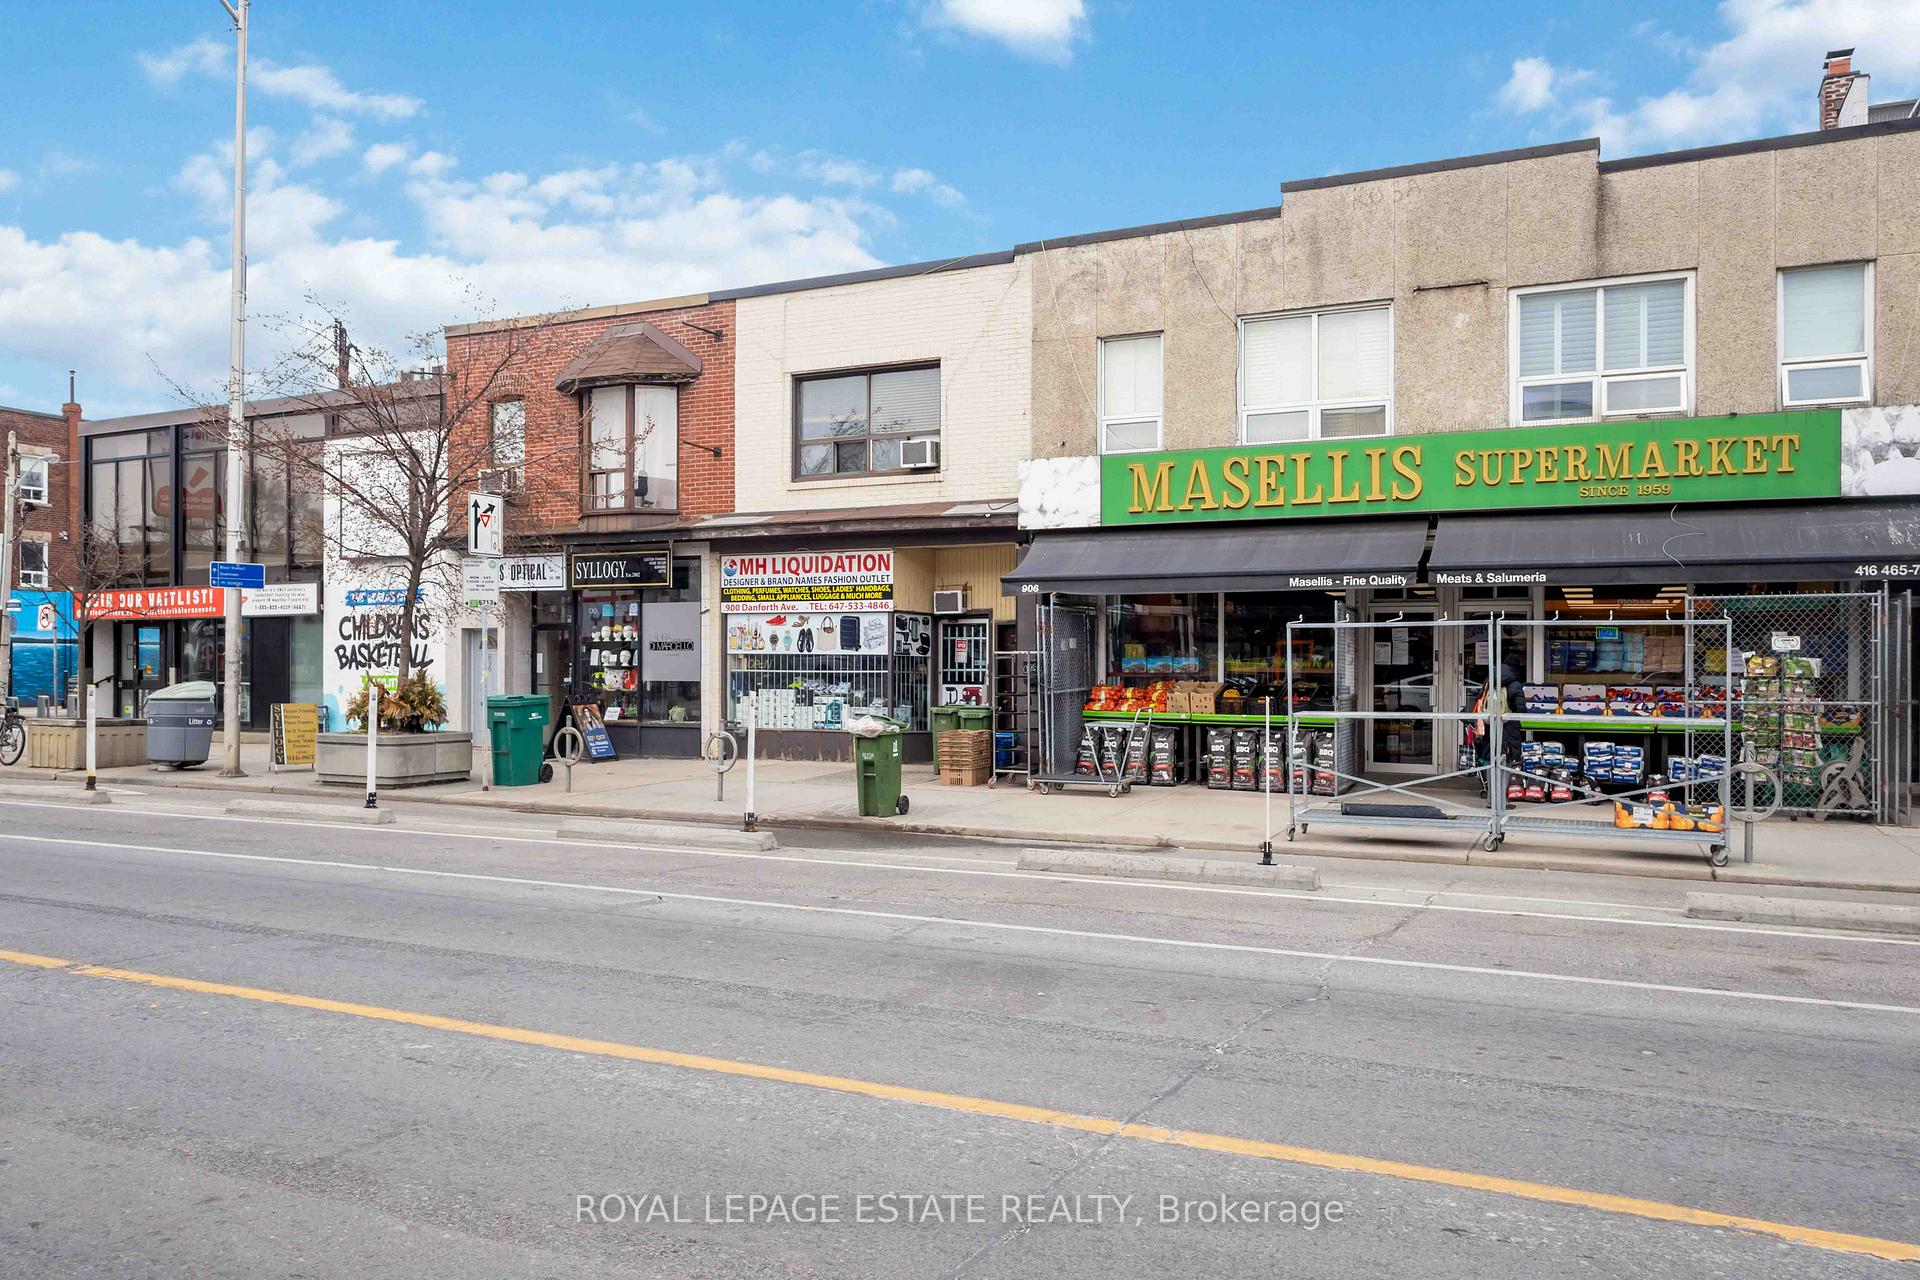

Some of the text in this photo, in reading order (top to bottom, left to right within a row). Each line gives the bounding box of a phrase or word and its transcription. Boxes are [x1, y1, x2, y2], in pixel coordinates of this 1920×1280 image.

[1128, 434, 1800, 513] MASELLIS SUPERMARKET
[1580, 484, 1672, 498] SINCE 1959
[576, 560, 627, 579] SYLLOGY
[739, 553, 890, 576] MH LIQUIDATION
[511, 563, 547, 581] OPTICAL
[1855, 565, 1878, 576] 416
[723, 574, 890, 586] DESIGNER & BRAND NAMES FASHION OUTLET
[1289, 576, 1333, 587] Masellis
[1343, 575, 1367, 586] Fine
[1369, 574, 1407, 586] Quality
[1436, 571, 1547, 584] Meats & Salumeria
[782, 586, 811, 594] WATCHES,
[855, 584, 891, 592] HANDBAGS,
[1021, 584, 1040, 593] 906
[119, 593, 143, 608] OUR
[776, 593, 812, 601] APPLIANCES,
[845, 592, 864, 600] MUCH
[725, 602, 799, 612] 900 Danforth Ave.
[809, 601, 890, 611] TEL: 647-533-4846
[189, 717, 204, 725] Litter
[273, 704, 286, 763] SYLLOGY
[1154, 742, 1169, 750] BBQ
[1211, 744, 1225, 752] BBQ
[1236, 746, 1250, 754] BBQ
[1319, 748, 1334, 757] BBQ
